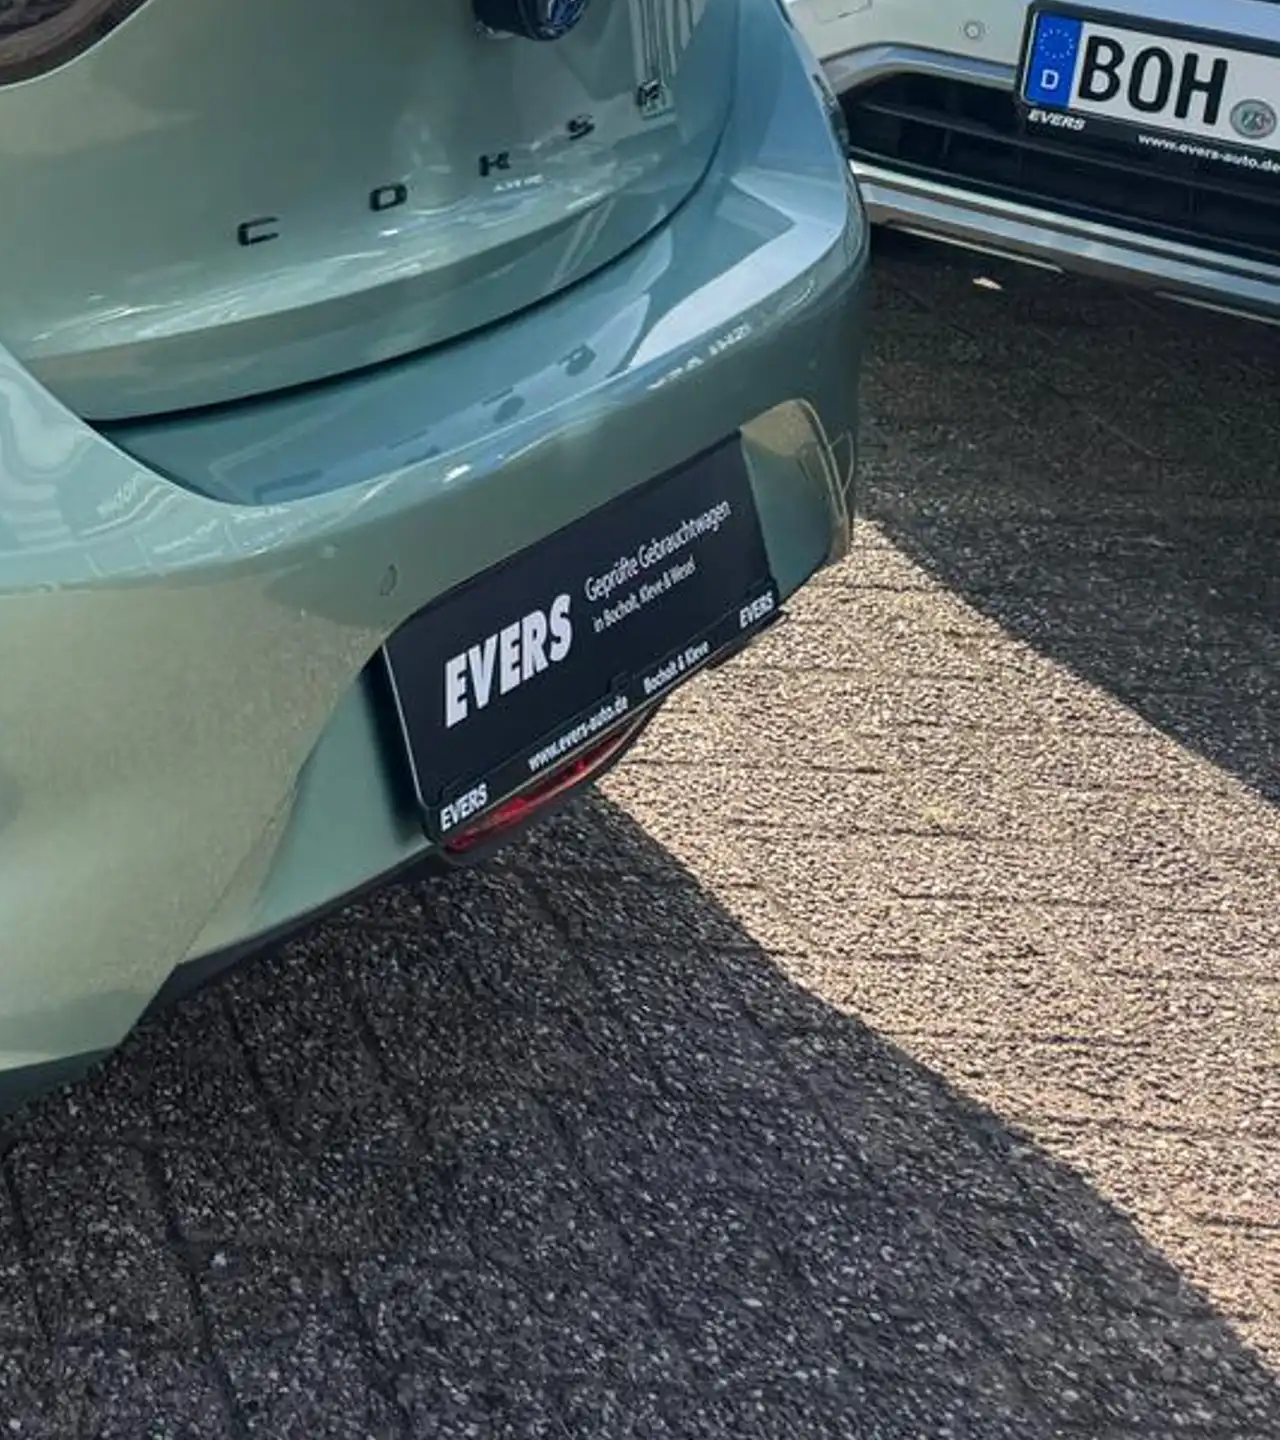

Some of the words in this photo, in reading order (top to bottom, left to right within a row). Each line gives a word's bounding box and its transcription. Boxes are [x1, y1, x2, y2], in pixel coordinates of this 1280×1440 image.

[1040, 69, 1059, 90] D
[1078, 35, 1229, 126] BOH
[1027, 110, 1086, 132] EVERS
[1138, 134, 1280, 174] www.evers-auto.de
[584, 557, 639, 602] Geprüfte
[638, 500, 732, 568] Gebrauchtwagen
[592, 616, 605, 633] in
[739, 590, 774, 629] EVERS
[444, 593, 573, 729] EVERS
[643, 660, 679, 695] Bocholt
[684, 640, 710, 667] Kleve
[528, 696, 628, 772] www.evers-auto.de
[440, 783, 487, 832] EVERS
